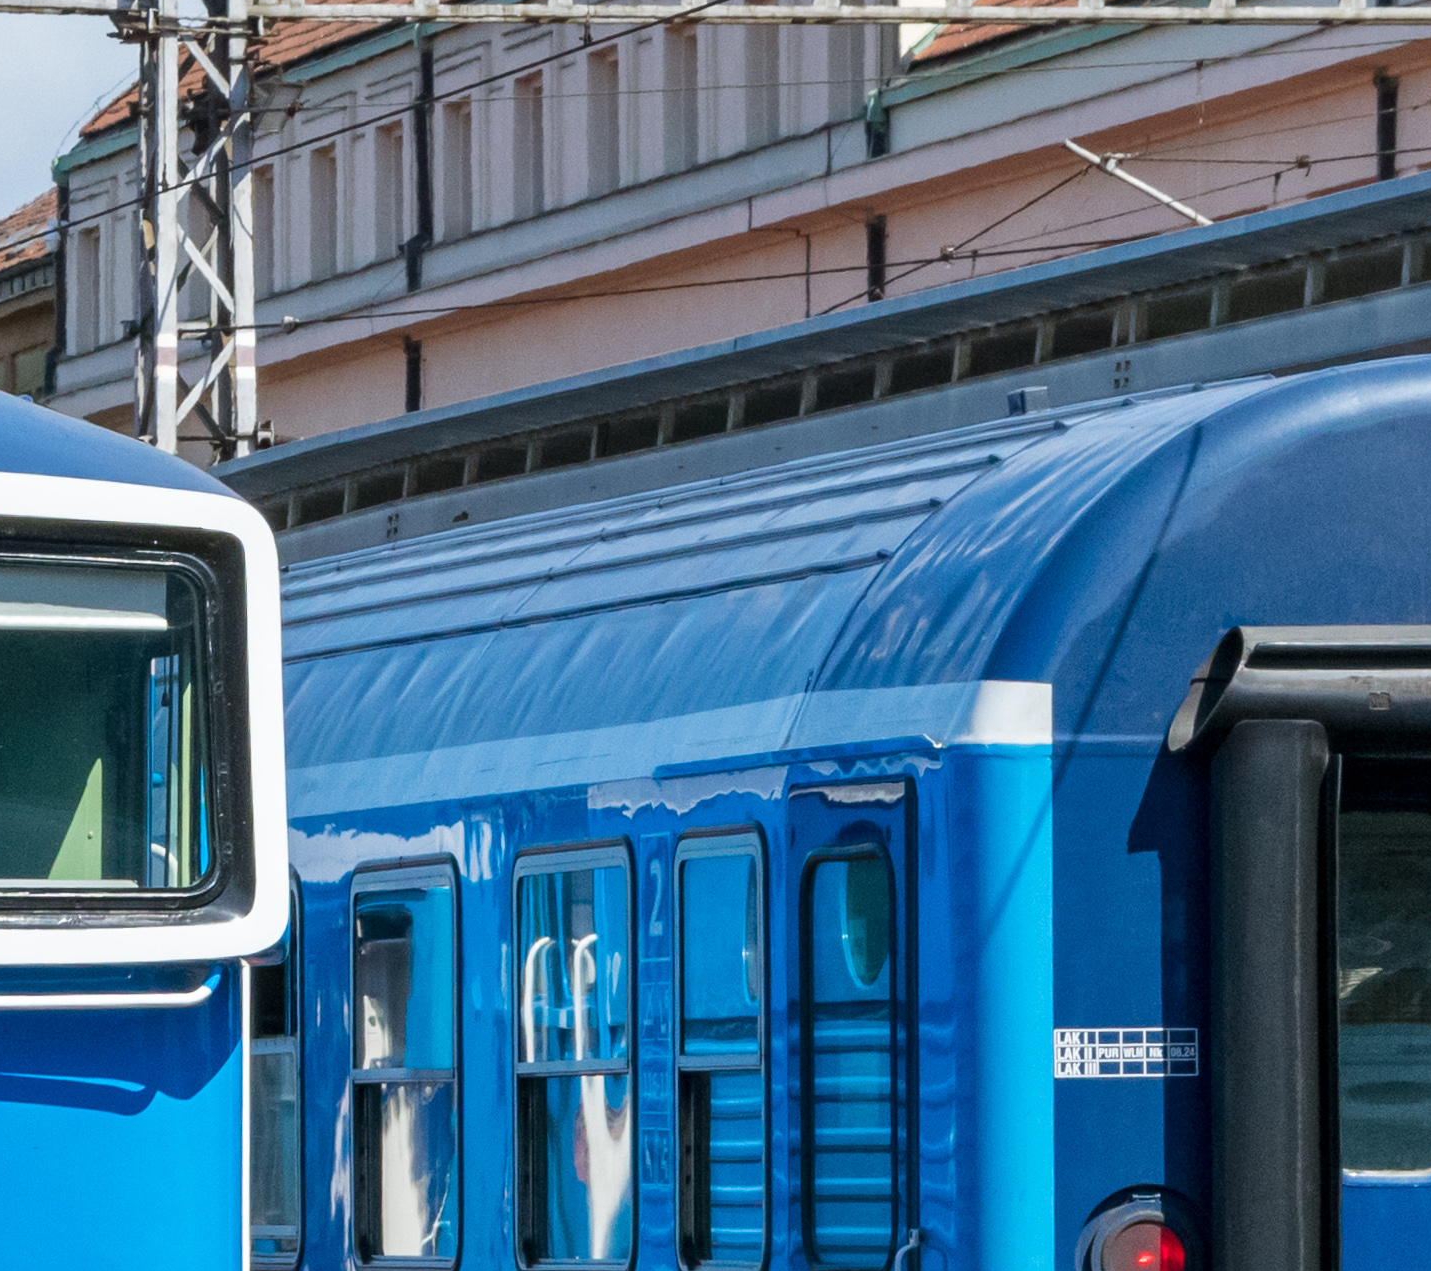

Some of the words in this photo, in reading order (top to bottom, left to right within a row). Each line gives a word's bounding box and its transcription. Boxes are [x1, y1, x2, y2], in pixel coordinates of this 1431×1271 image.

[649, 859, 663, 937] 2
[1056, 1031, 1080, 1045] LAK
[1056, 1047, 1080, 1060] LAK
[1099, 1047, 1119, 1058] PUR
[1056, 1062, 1080, 1075] LAK
